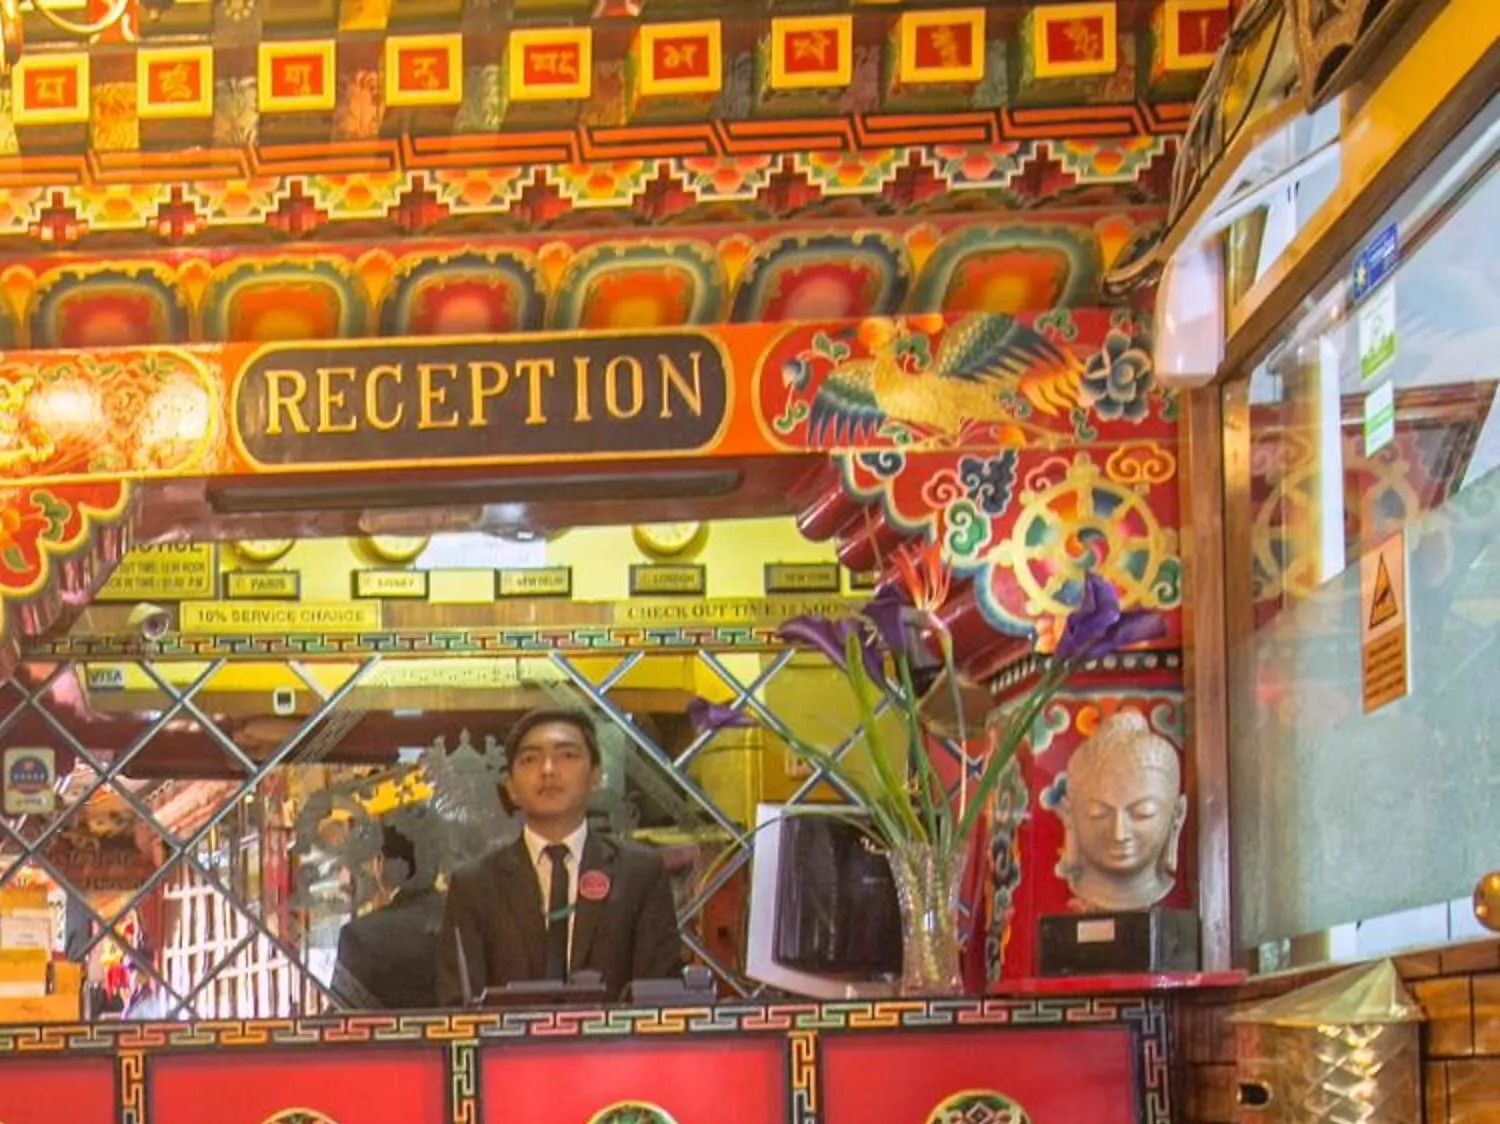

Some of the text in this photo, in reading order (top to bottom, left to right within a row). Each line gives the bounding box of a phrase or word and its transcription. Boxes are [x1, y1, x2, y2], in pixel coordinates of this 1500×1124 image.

[263, 351, 703, 435] RECEPTION
[251, 577, 285, 590] PARIS
[198, 609, 227, 622] 10%
[231, 609, 296, 622] SERVICE
[627, 605, 688, 620] CHECK
[689, 603, 726, 619] OUT
[732, 603, 776, 617] TIME
